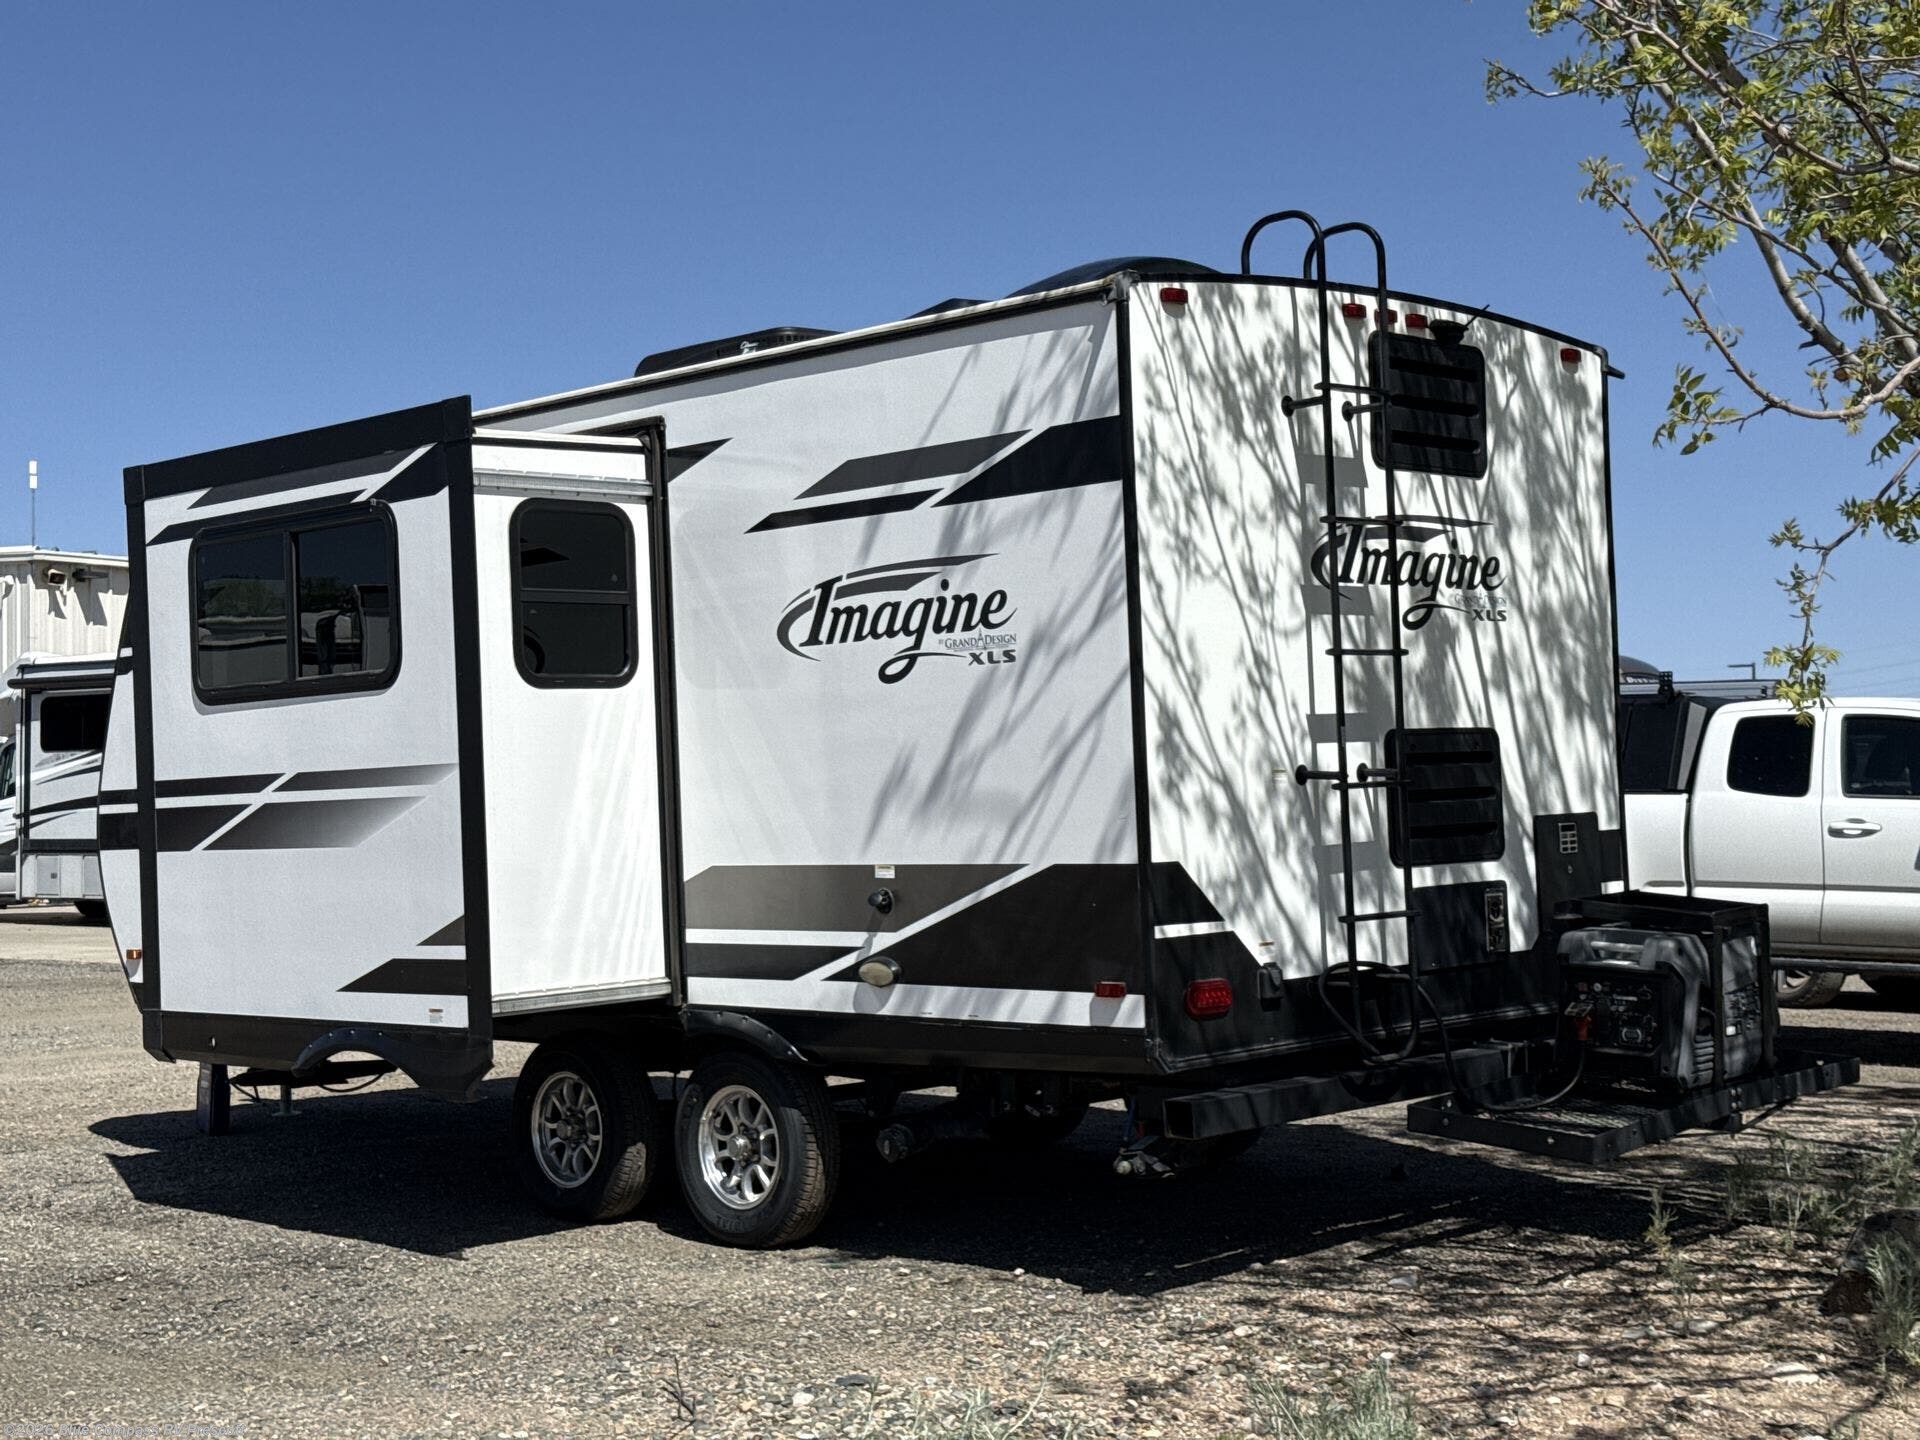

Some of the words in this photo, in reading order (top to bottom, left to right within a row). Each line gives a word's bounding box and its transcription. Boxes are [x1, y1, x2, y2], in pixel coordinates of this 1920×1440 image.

[1338, 522, 1507, 630] Imagine
[1472, 608, 1507, 621] XLS
[799, 574, 1018, 684] Imagine
[945, 637, 977, 649] GRAND
[985, 633, 1017, 645] DESIGN
[968, 649, 1017, 666] XLS
